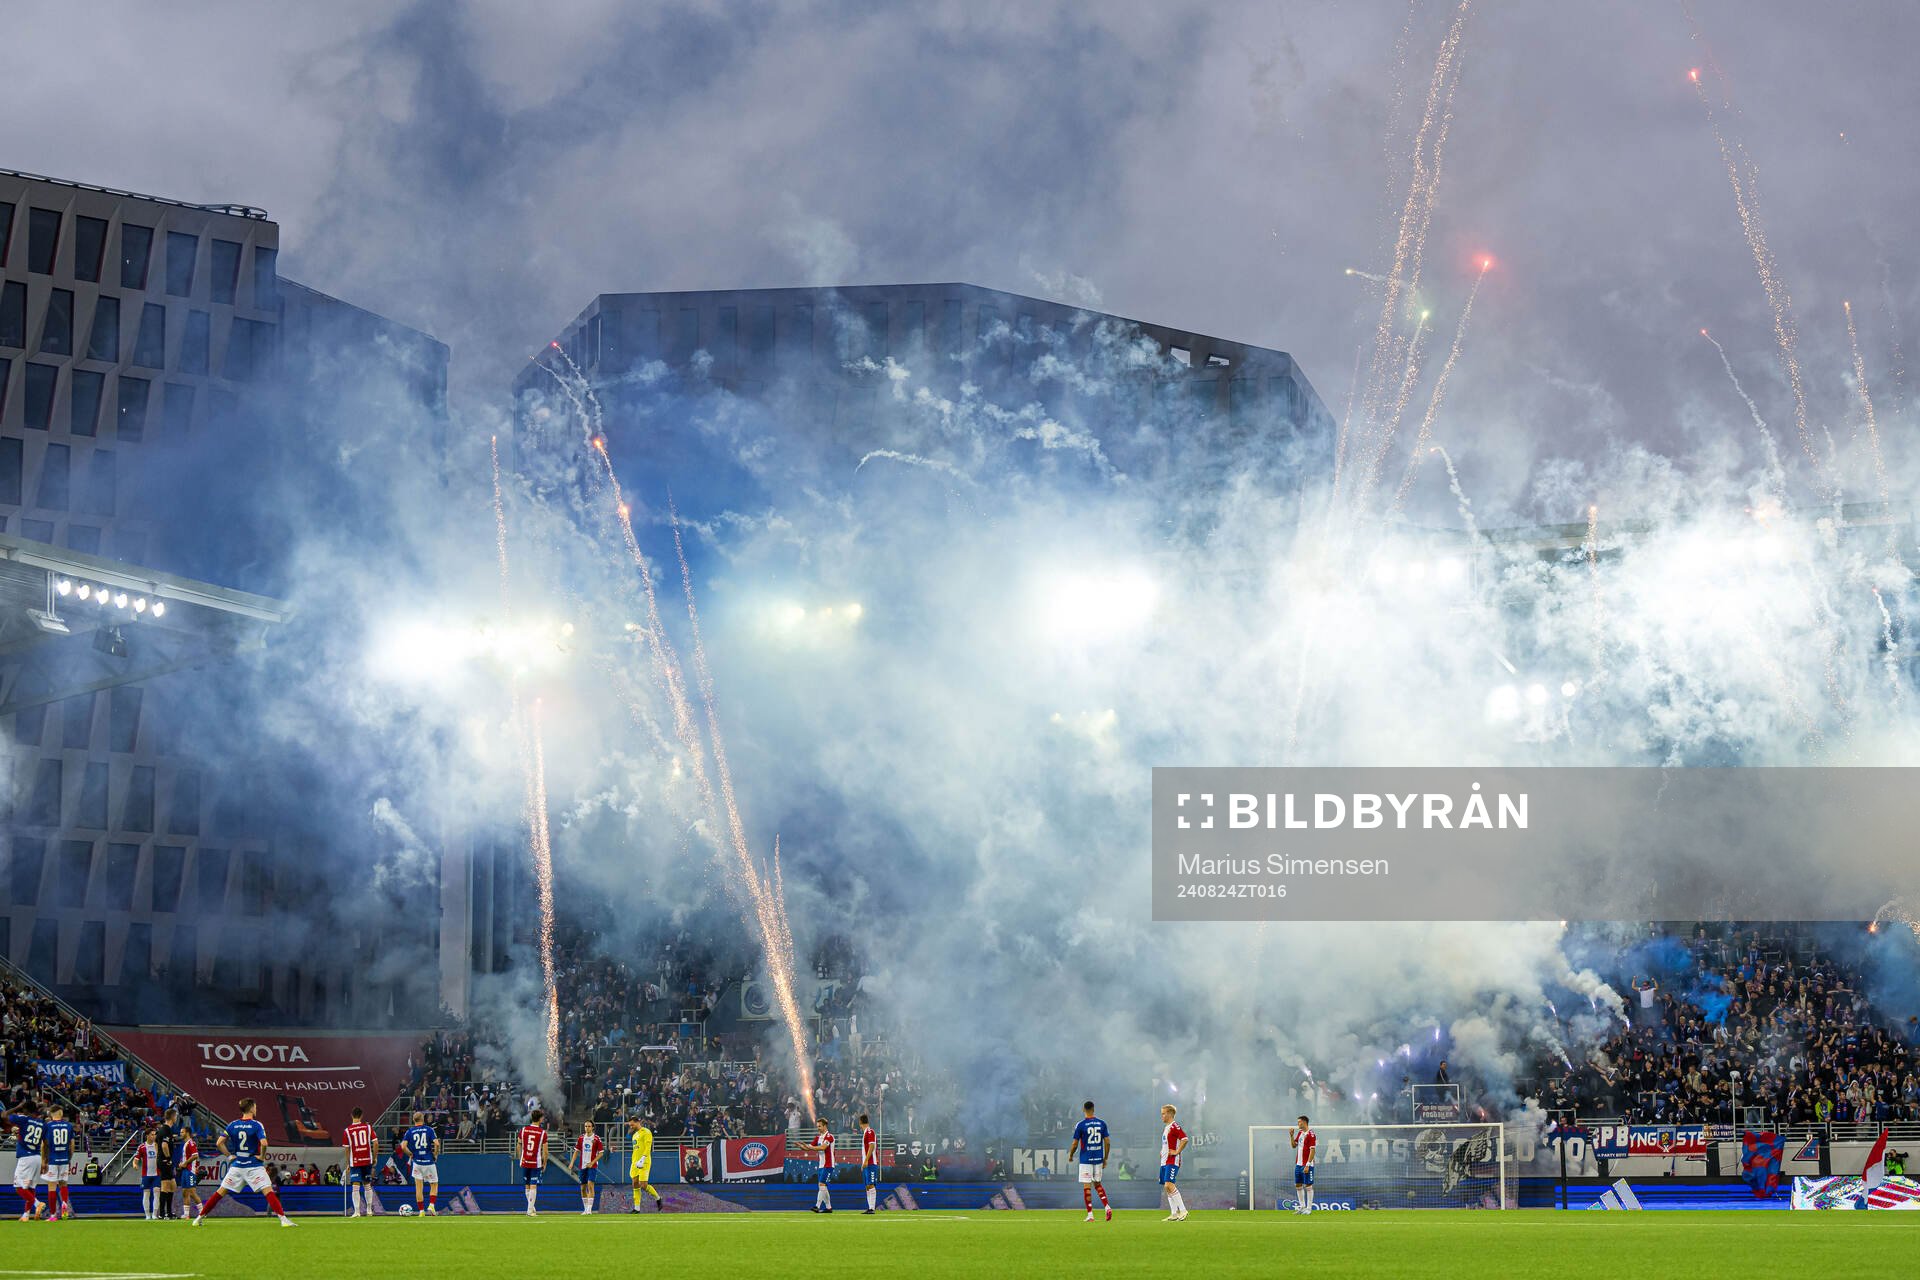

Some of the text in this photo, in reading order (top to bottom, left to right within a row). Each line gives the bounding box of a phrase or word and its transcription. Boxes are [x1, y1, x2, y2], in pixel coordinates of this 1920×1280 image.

[198, 1043, 309, 1063] TOYOTA
[205, 1077, 366, 1091] MATERIAL HANDLING
[24, 1125, 43, 1145] 29
[53, 1128, 68, 1145] 80
[238, 1131, 249, 1151] 2
[351, 1130, 367, 1147] 10
[413, 1132, 428, 1150] 24
[526, 1134, 536, 1151] 5
[1087, 1126, 1102, 1144] 25
[1629, 1132, 1657, 1148] YNG
[265, 1152, 297, 1162] OYOTA
[1313, 1138, 1409, 1164] AROS
